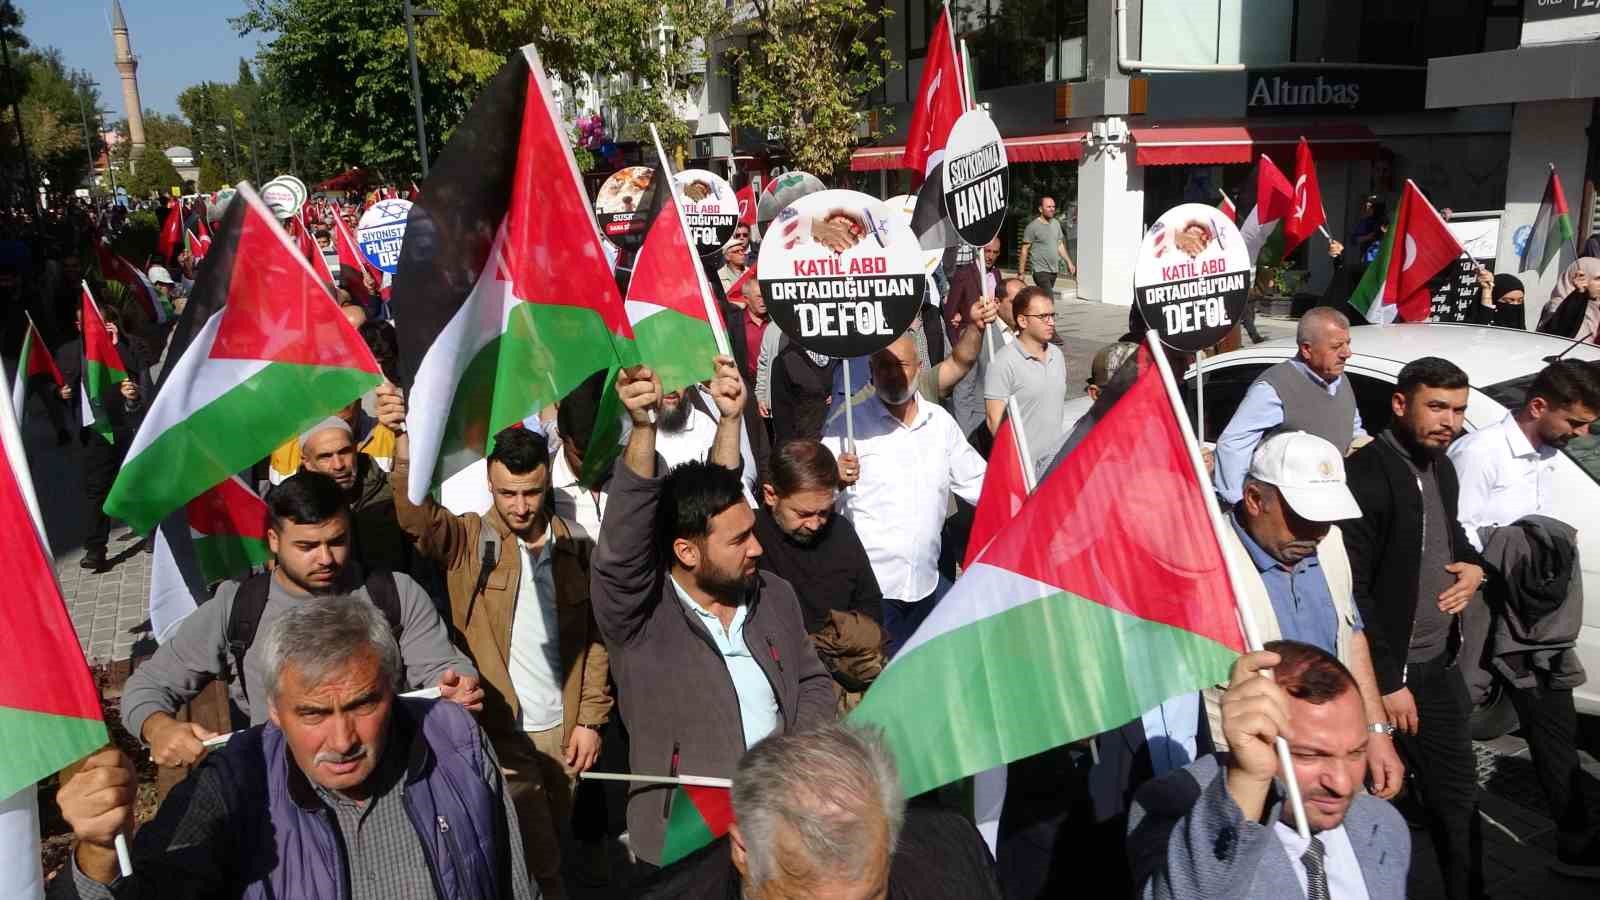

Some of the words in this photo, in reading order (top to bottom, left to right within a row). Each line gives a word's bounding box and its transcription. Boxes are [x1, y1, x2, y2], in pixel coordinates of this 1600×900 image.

[1247, 76, 1360, 110] Altınbaş
[950, 145, 1000, 185] SOYKIRIMA
[684, 203, 698, 213] TİL
[701, 204, 721, 214] ABD
[954, 174, 1005, 230] HAYIR!
[690, 226, 721, 245] FOL
[378, 250, 400, 267] DE
[793, 255, 846, 276] KATİL
[850, 256, 887, 275] ABD
[1162, 260, 1198, 281] KATİL
[1201, 258, 1226, 276] ABD
[771, 276, 914, 301] ORTADOĞU'DAN
[1145, 275, 1245, 305] ORTADOĞU'DAN
[794, 301, 894, 337] DEFOL
[1162, 296, 1232, 336] DEFOL
